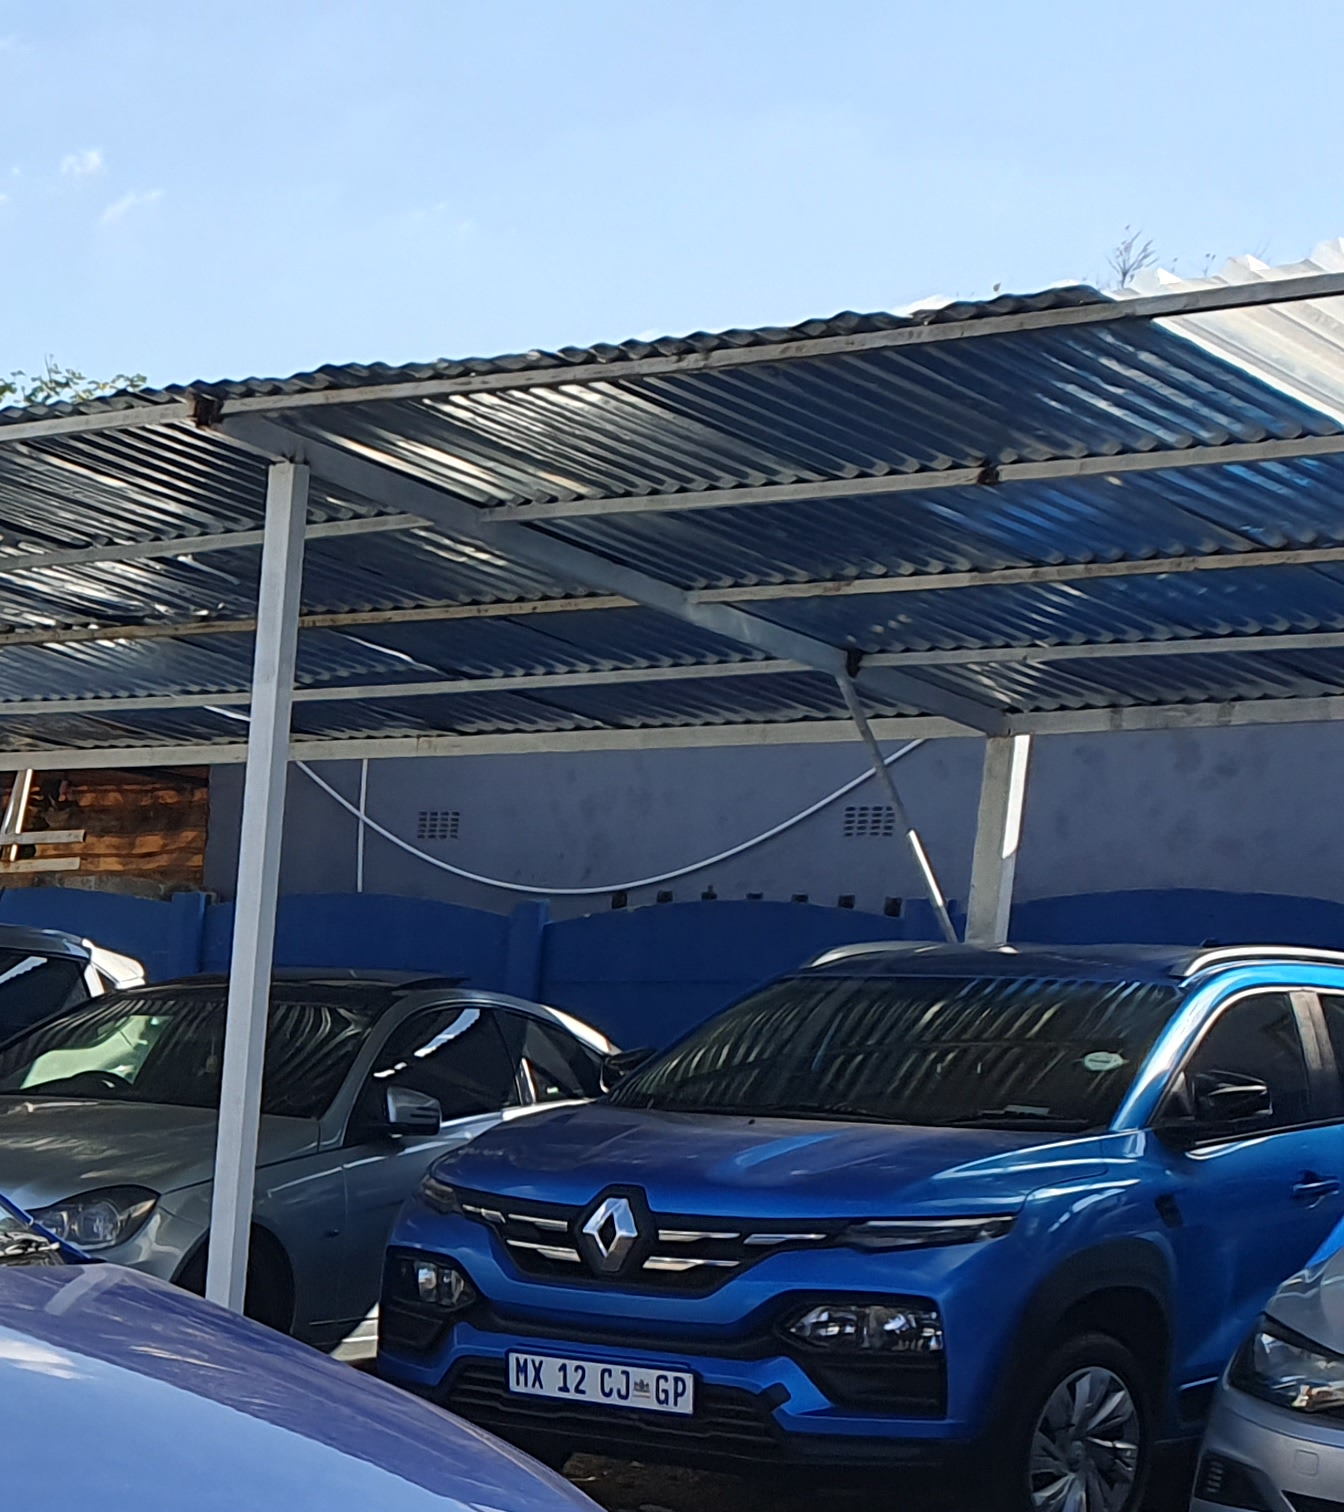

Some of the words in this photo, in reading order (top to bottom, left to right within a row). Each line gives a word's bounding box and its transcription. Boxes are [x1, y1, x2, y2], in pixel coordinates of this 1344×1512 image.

[515, 1355, 544, 1390] MX
[557, 1362, 587, 1396] 12
[599, 1367, 631, 1401] CJ
[654, 1373, 687, 1408] GP
